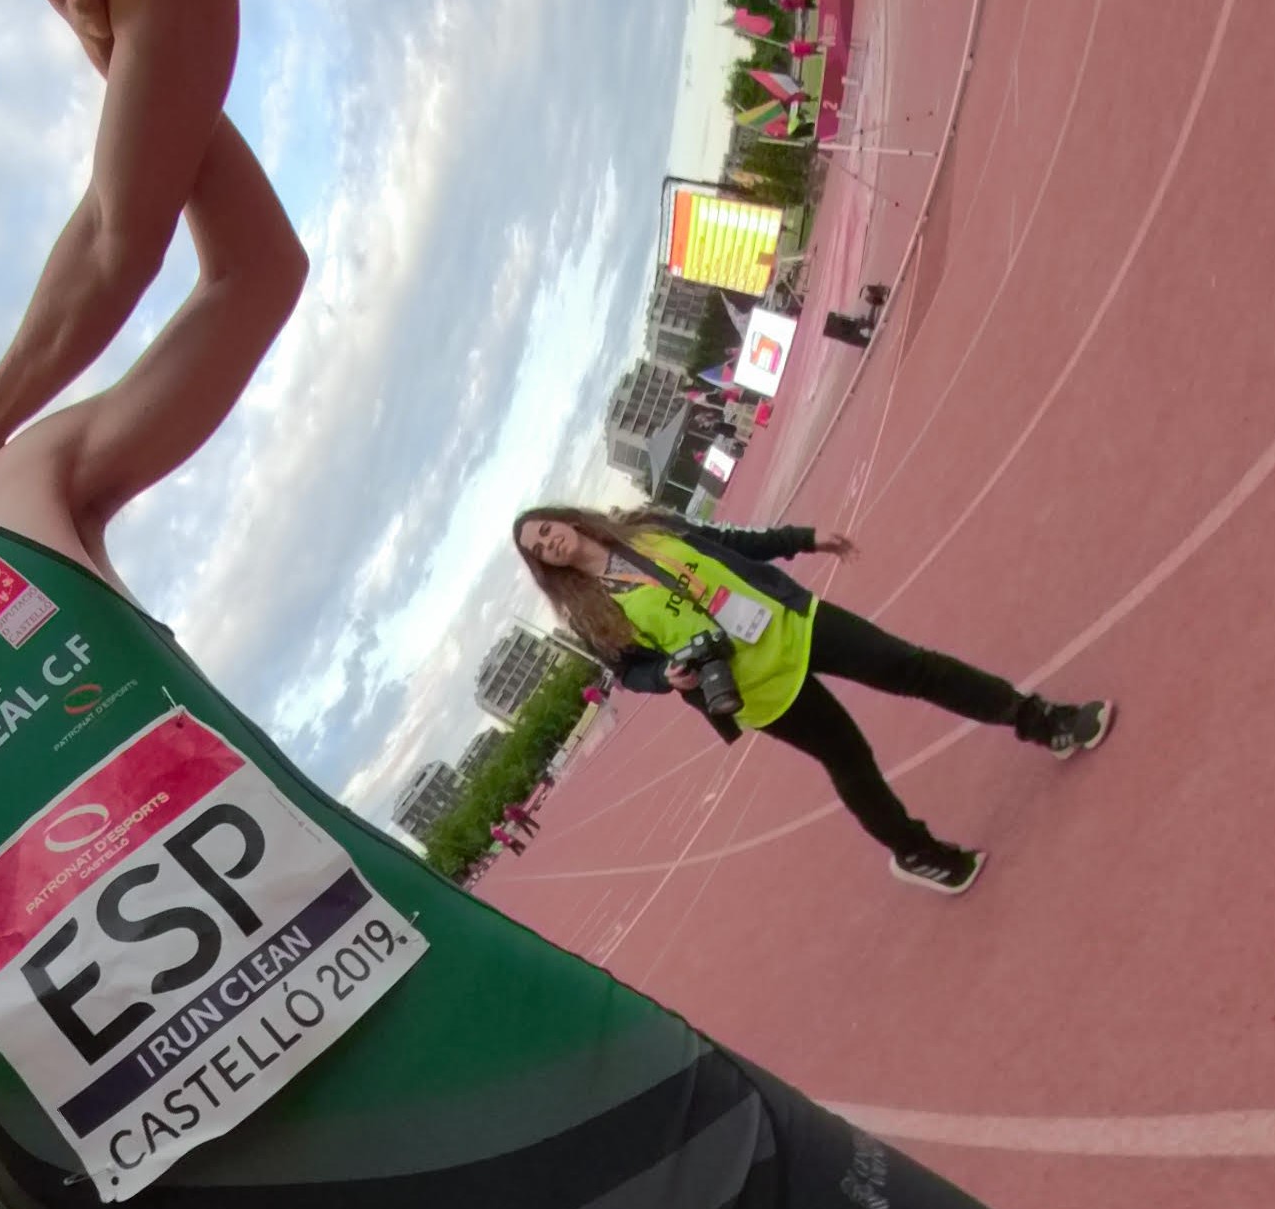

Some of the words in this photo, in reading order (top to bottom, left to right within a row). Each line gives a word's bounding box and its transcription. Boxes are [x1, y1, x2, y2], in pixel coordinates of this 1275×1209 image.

[53, 712, 97, 752] PATRONAT
[96, 678, 139, 715] D'ESPORTS
[25, 849, 93, 916] PATRONAT
[94, 791, 170, 852] D'ESPORTS
[19, 802, 266, 1066] ESP
[219, 925, 313, 1009] CLEAN
[108, 981, 325, 1171] CASTELLÓ
[316, 919, 397, 1004] 2019
